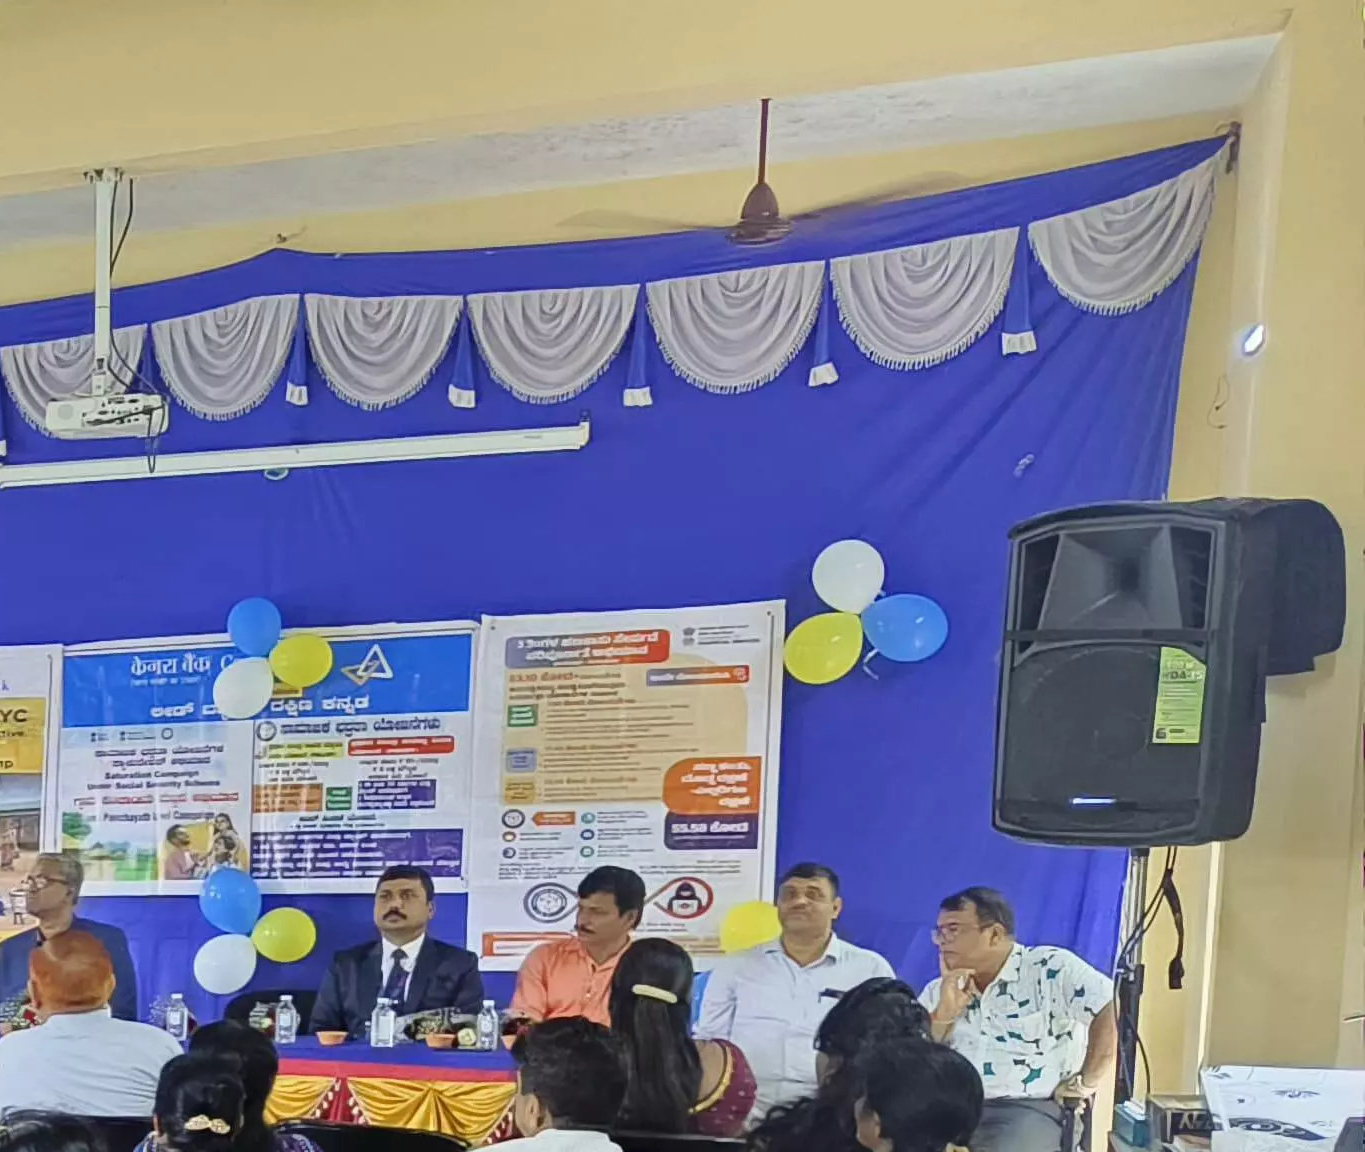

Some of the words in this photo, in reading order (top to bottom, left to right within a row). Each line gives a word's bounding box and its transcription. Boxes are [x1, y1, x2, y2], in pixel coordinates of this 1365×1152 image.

[130, 656, 178, 676] केनरा
[182, 652, 211, 674] बैंक
[321, 694, 369, 715] ಕನ್ನಡ
